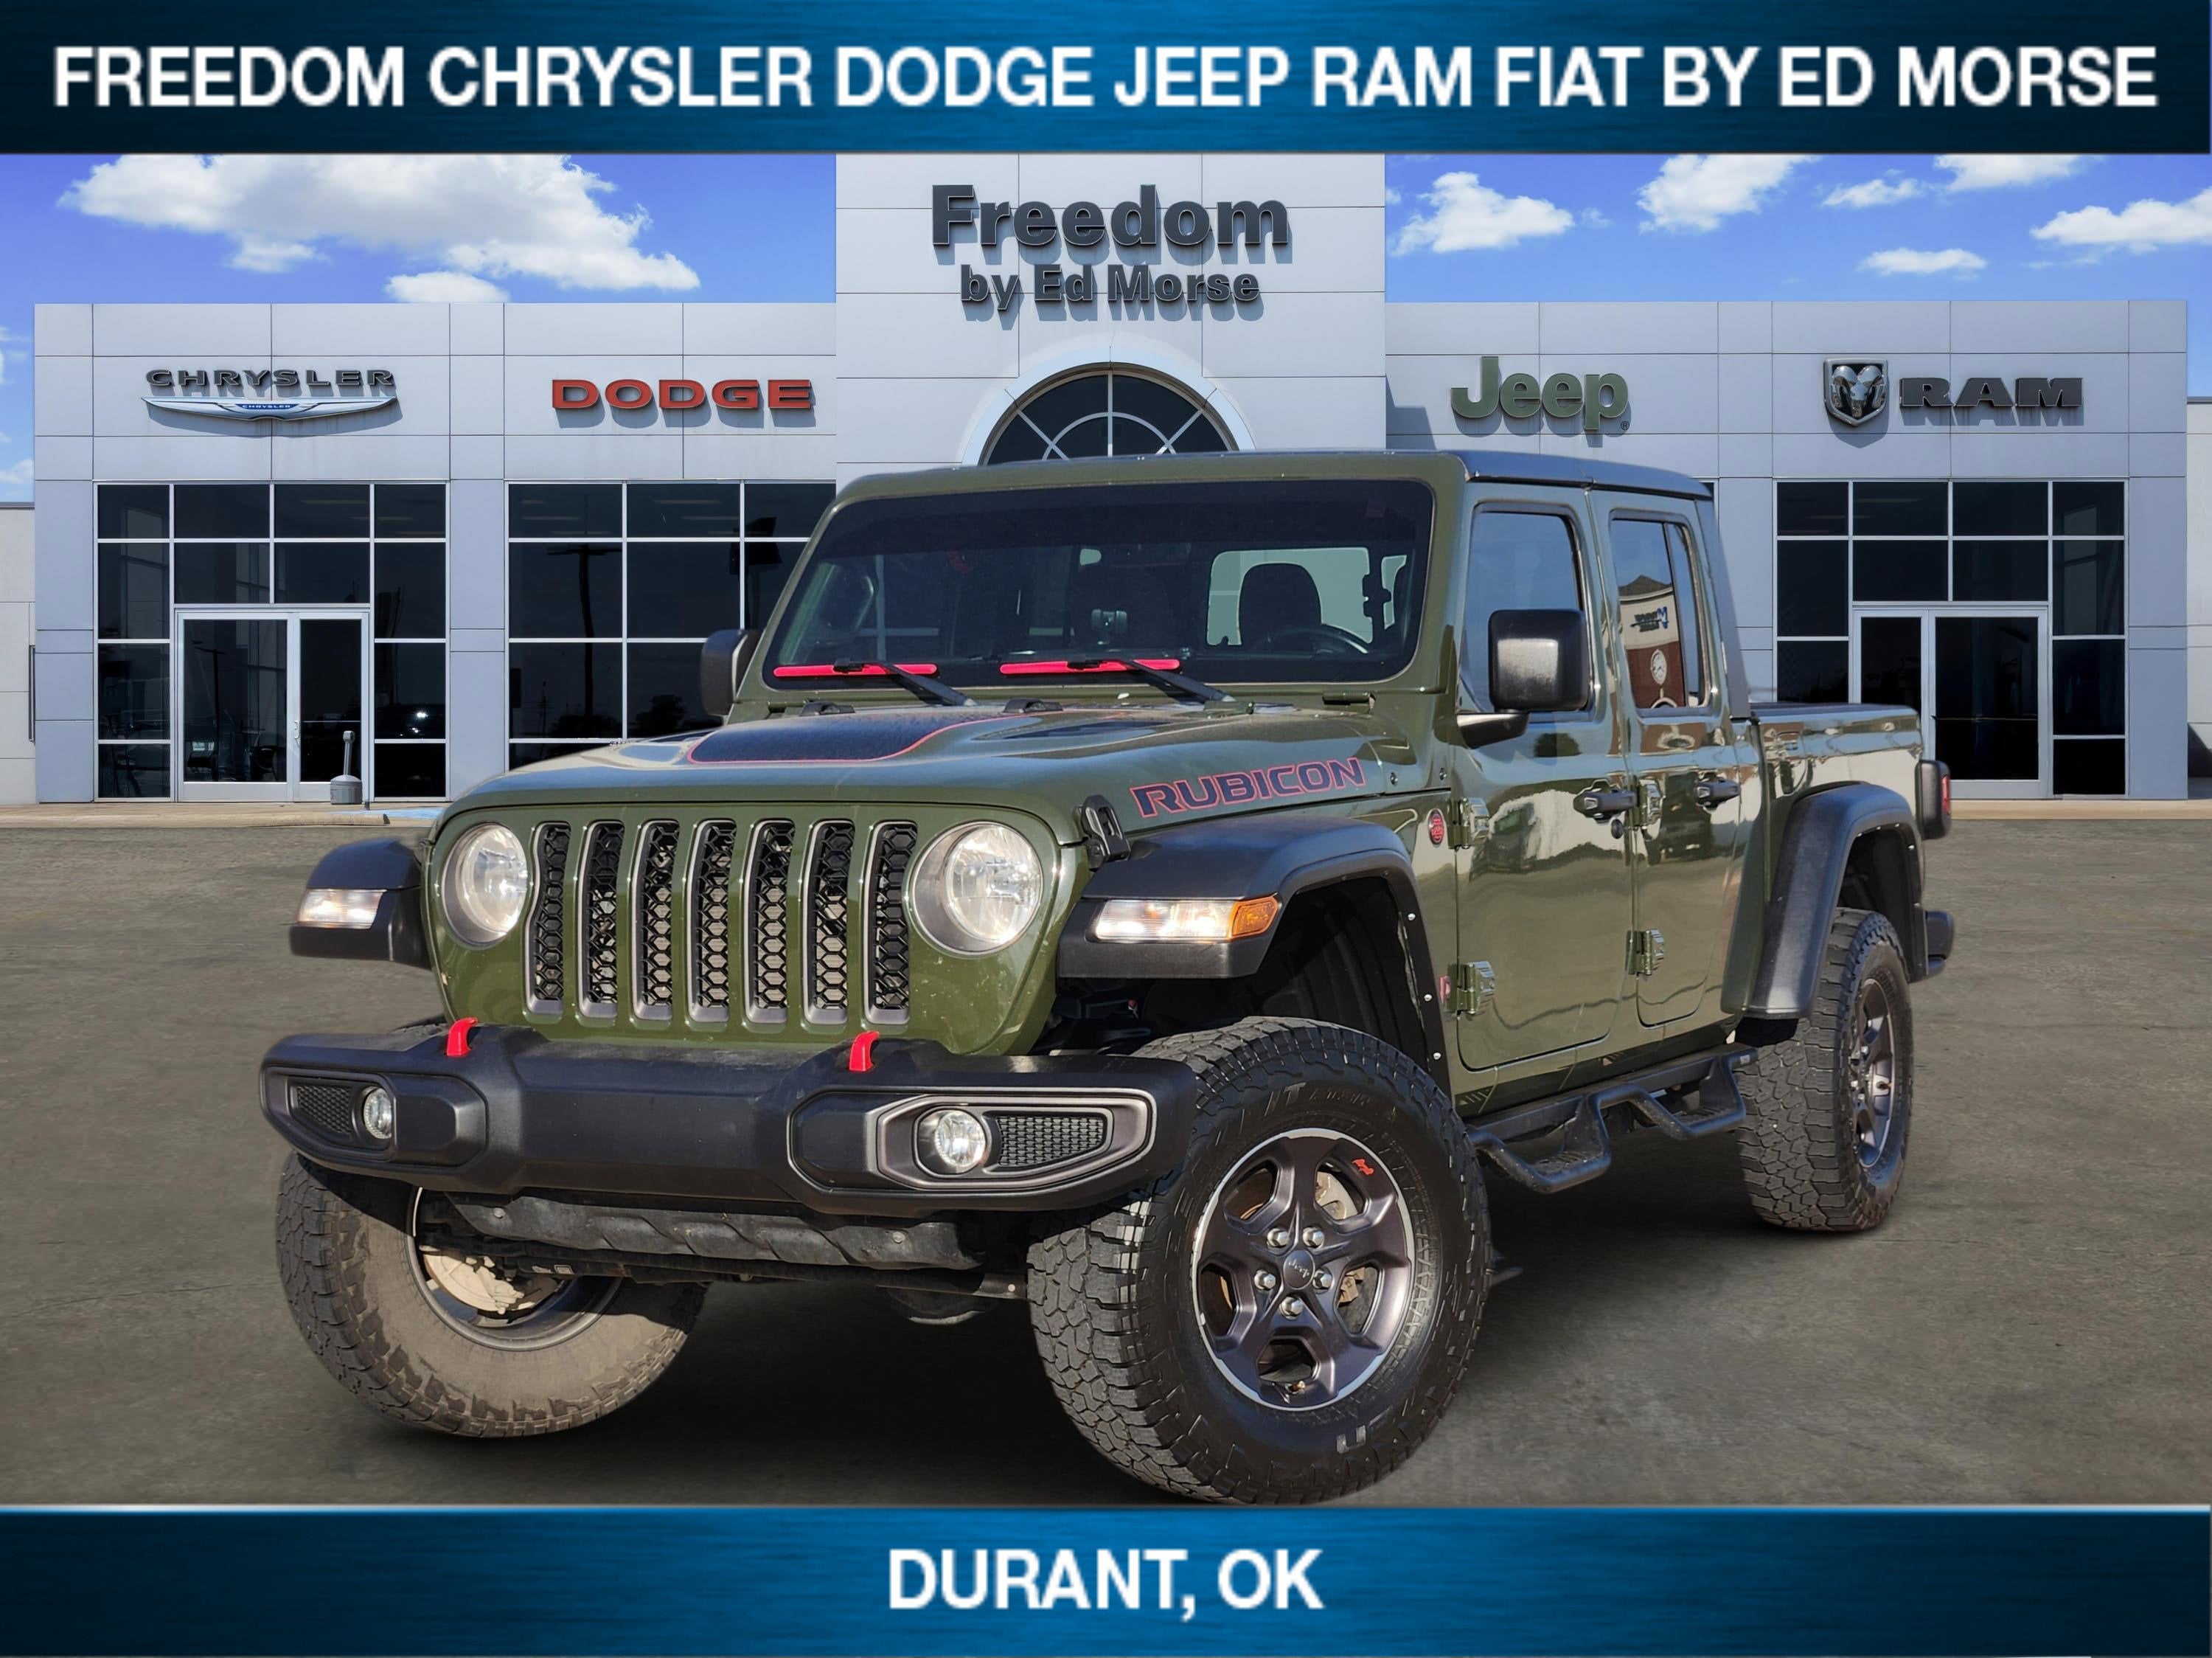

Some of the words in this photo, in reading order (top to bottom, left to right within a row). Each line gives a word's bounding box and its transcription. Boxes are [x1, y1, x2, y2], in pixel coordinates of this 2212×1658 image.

[932, 184, 1289, 246] Freedom
[961, 264, 1019, 311] by
[1034, 264, 1093, 302] Ed
[1107, 264, 1260, 302] Morse
[145, 369, 394, 387] CHRYSLER
[552, 378, 812, 409] DODGE
[1450, 355, 1629, 430] Jeep
[1899, 377, 2084, 406] RAM
[1130, 757, 1366, 819] RUBICON
